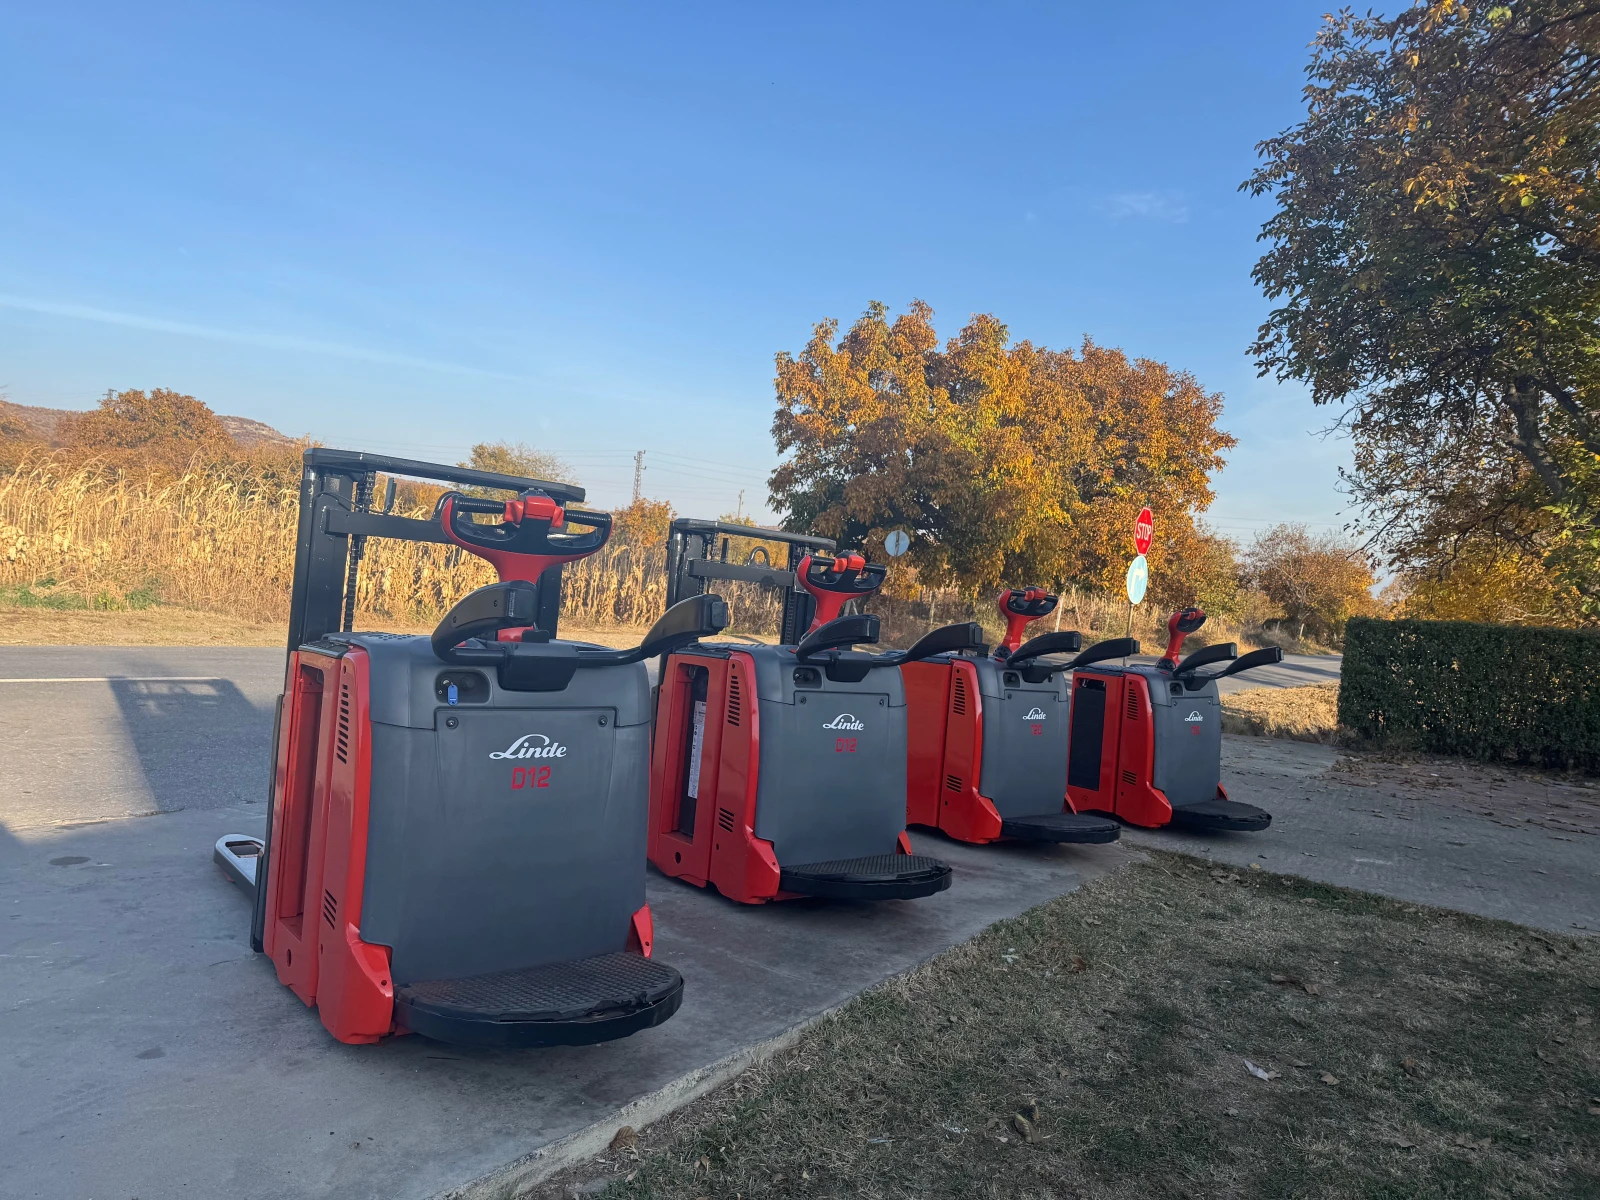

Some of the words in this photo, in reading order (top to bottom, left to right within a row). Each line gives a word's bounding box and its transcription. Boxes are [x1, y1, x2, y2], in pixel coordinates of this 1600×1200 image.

[1137, 522, 1151, 541] STOP
[822, 713, 864, 731] Linde
[1022, 707, 1046, 720] Linde
[489, 734, 567, 760] Linde
[835, 737, 858, 753] D12
[511, 765, 551, 790] D12
